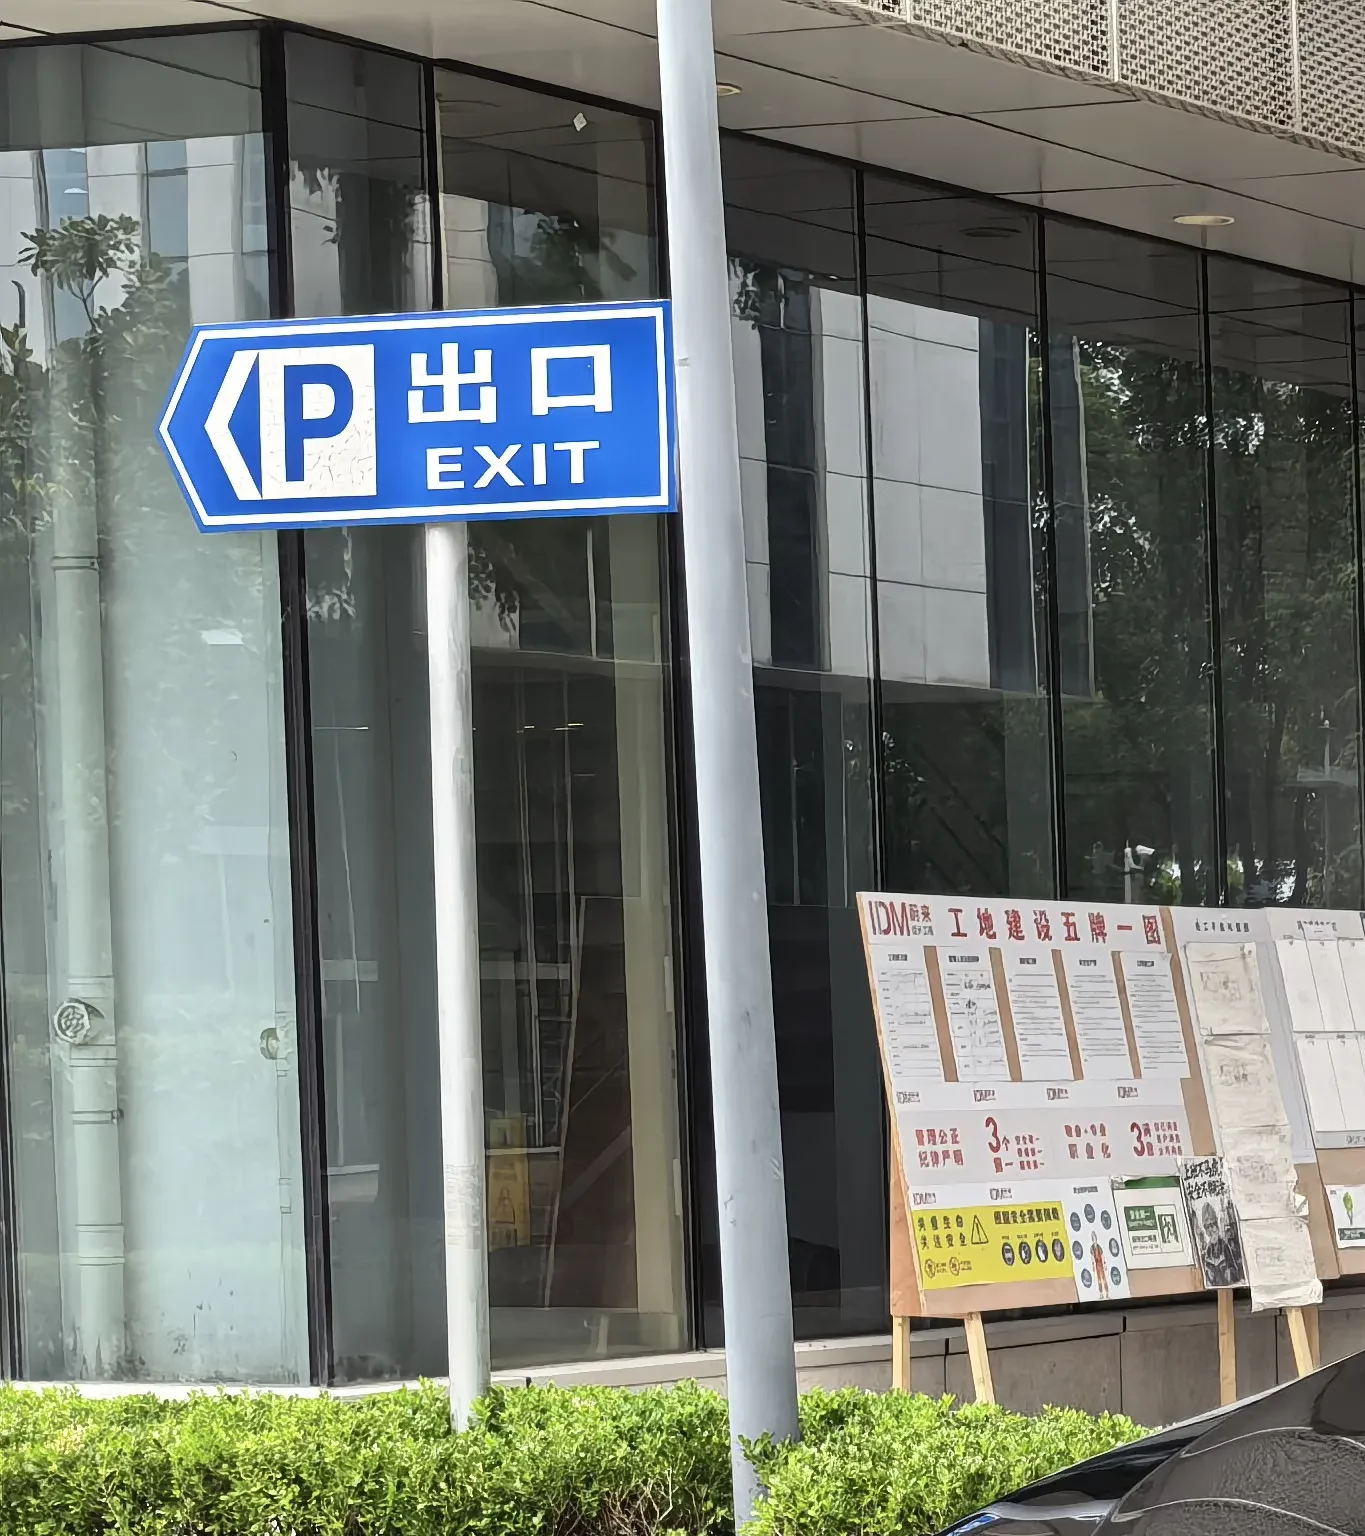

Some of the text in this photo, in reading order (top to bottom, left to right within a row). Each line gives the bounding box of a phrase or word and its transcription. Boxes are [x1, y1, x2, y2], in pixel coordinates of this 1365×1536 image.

[408, 342, 613, 424] 出口
[283, 362, 354, 483] P
[426, 440, 600, 490] EXIT
[948, 907, 1162, 945] 工地建设五牌一图
